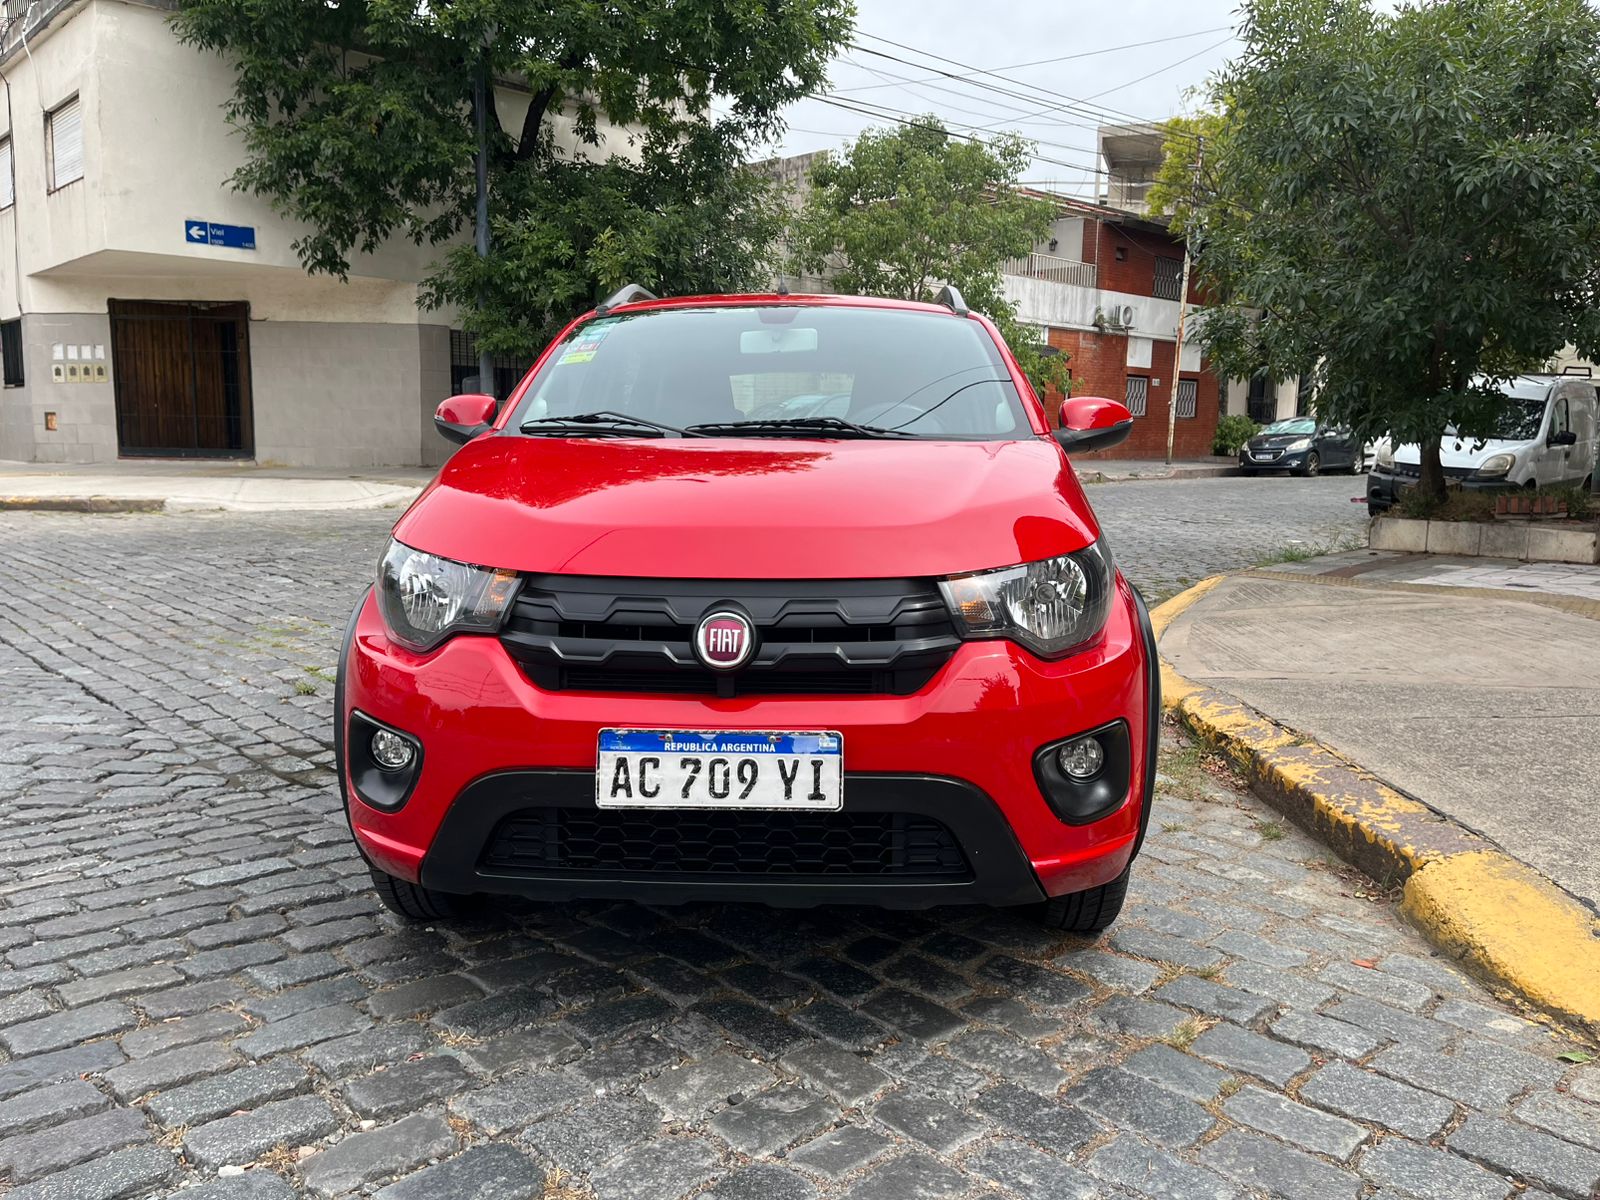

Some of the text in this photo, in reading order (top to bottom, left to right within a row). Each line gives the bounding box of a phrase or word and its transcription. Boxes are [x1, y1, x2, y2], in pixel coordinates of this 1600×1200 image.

[709, 628, 741, 653] FIAT
[664, 742, 776, 753] REPUBLICA ARGENTINA
[610, 756, 827, 801] AC 709 YI
